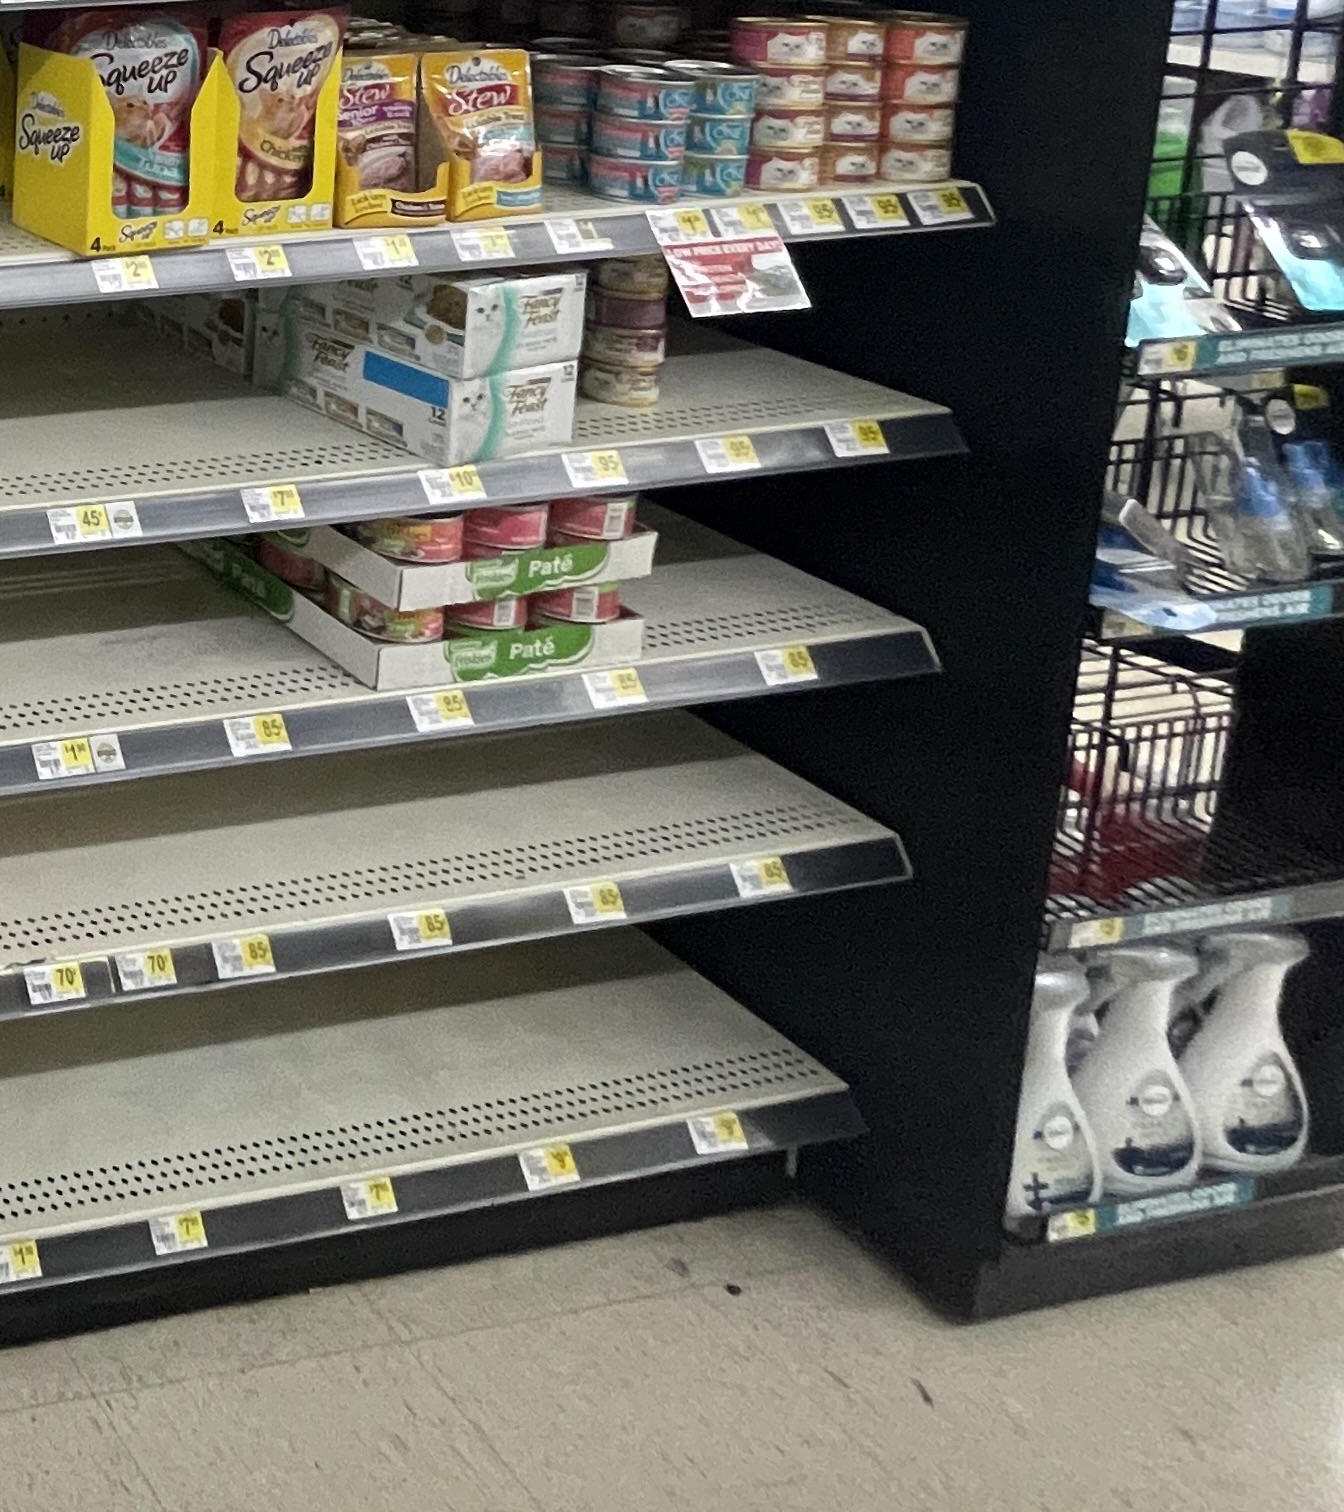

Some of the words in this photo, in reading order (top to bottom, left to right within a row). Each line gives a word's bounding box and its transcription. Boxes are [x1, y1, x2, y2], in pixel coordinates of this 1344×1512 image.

[239, 41, 332, 93] Squeeze
[146, 69, 174, 94] UP
[339, 83, 391, 107] Stew
[447, 85, 512, 113] Stew
[18, 114, 81, 149] Squeeze
[50, 141, 70, 162] UP
